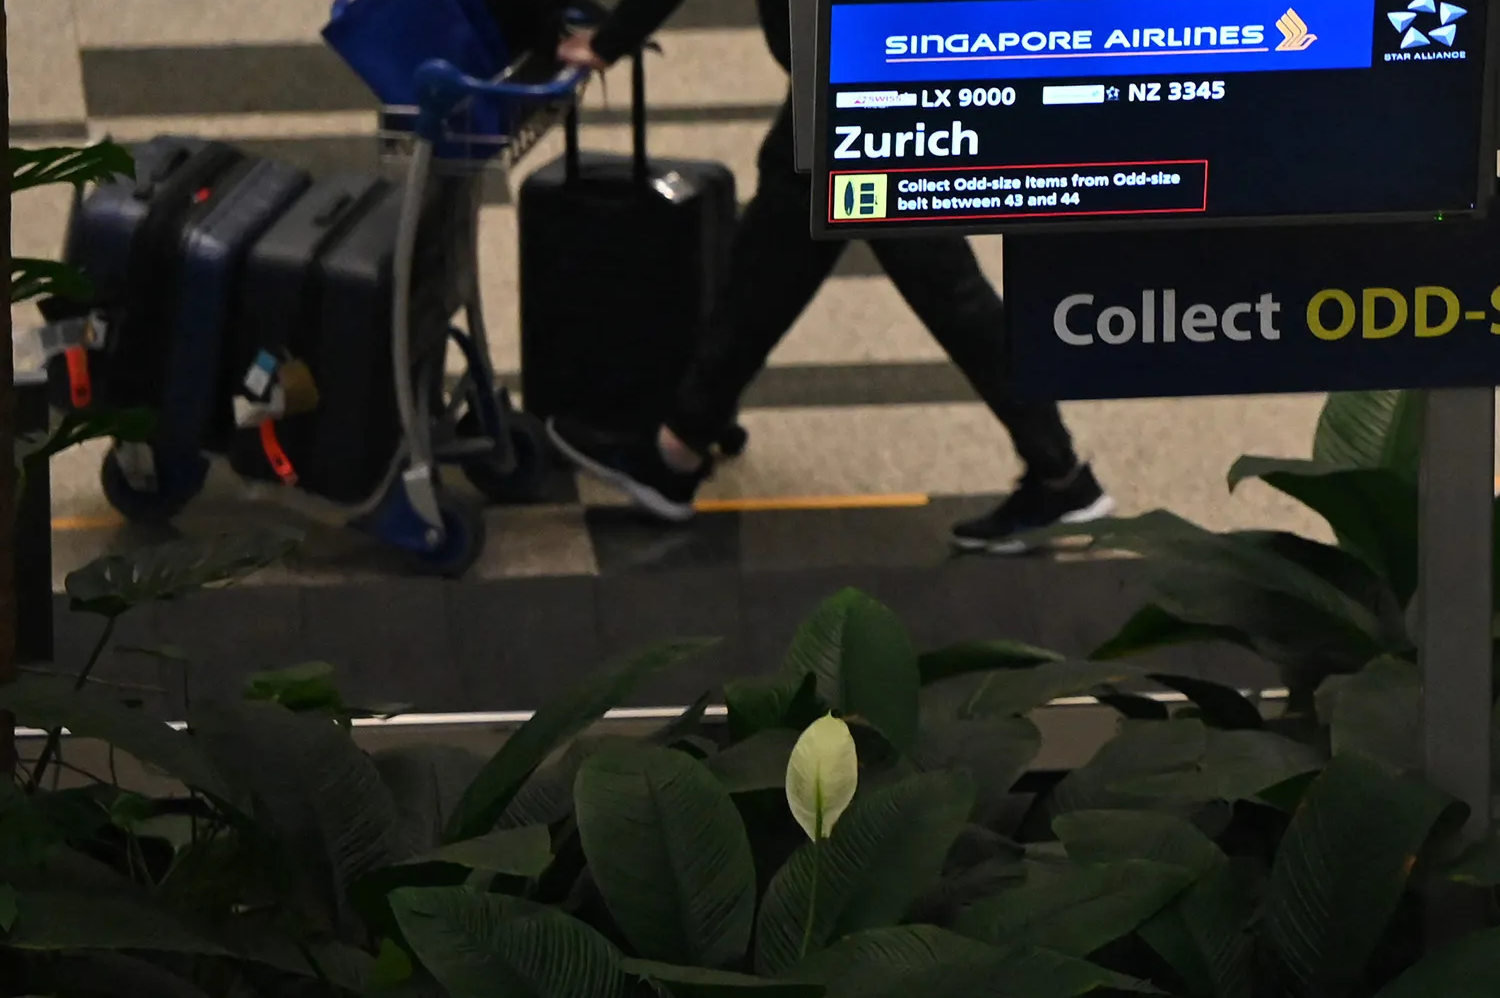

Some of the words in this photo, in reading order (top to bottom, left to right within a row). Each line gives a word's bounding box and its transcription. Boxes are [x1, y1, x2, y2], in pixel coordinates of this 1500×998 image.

[885, 30, 1093, 55] SINGAPORE
[1103, 24, 1265, 49] AIRLINES
[1383, 52, 1411, 62] STAR
[1413, 50, 1466, 60] ALLIANCE
[921, 88, 952, 108] LX
[958, 86, 1016, 107] 9000
[1128, 82, 1162, 102] NZ
[1167, 80, 1226, 101] 3345
[833, 120, 979, 159] Zurich
[897, 178, 951, 193] Collect
[953, 176, 1022, 191] Odd-size
[1070, 173, 1110, 188] from
[1112, 171, 1181, 187] Odd-size
[897, 196, 929, 211] belt
[931, 195, 1001, 210] between
[1004, 193, 1024, 207] 43
[1027, 191, 1057, 207] and
[1060, 191, 1081, 206] 44
[1053, 288, 1281, 346] Collect
